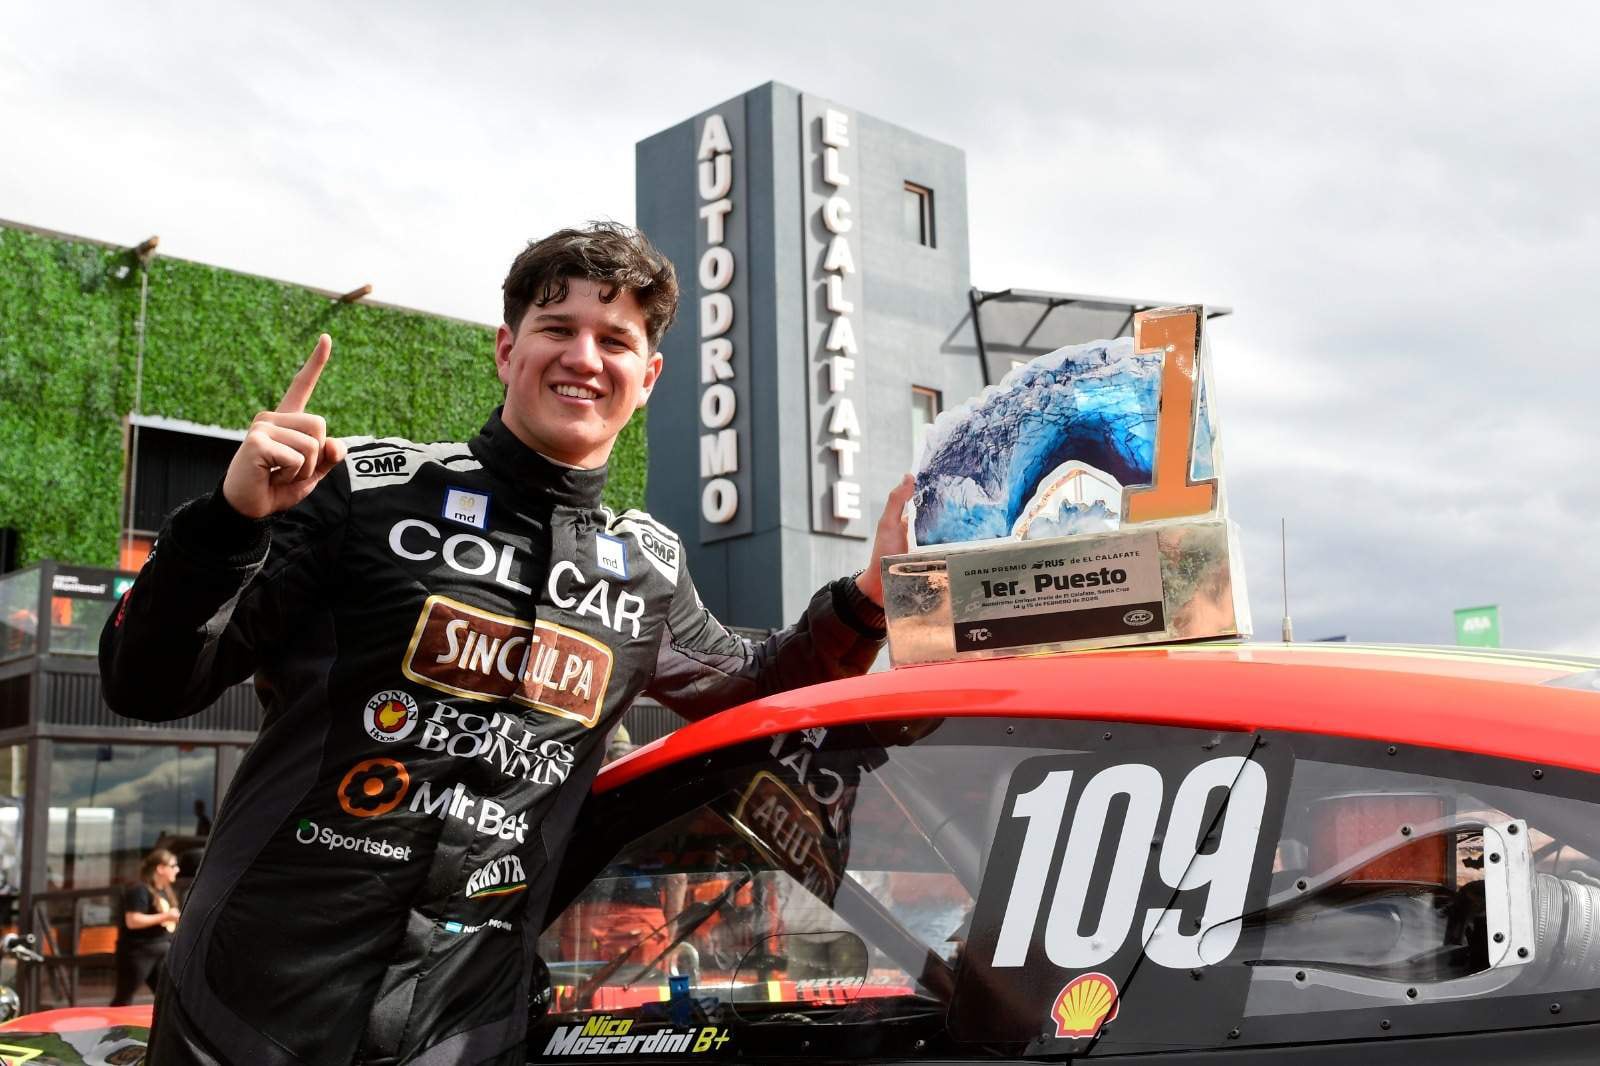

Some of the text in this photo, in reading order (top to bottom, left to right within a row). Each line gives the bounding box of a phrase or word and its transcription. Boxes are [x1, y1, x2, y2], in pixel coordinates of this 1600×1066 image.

[697, 114, 739, 524] AUTODROMO
[822, 196, 862, 520] CALAFATE
[355, 454, 407, 474] OMP
[454, 512, 476, 524] md
[641, 532, 676, 562] OMP
[602, 556, 618, 569] md
[964, 567, 990, 577] GRAN
[991, 563, 1027, 574] PREMIO
[1045, 558, 1065, 569] RUS
[1095, 551, 1141, 562] CALAFATE
[388, 518, 645, 639] COL CAR
[981, 566, 1127, 599] 1er. Puesto
[367, 691, 417, 721] BONNIN
[318, 827, 412, 862] Sportsbet
[466, 854, 526, 898] RASTA
[991, 756, 1268, 969] 109
[542, 1025, 730, 1055] Moscardini B+
[581, 1015, 634, 1036] Nico
